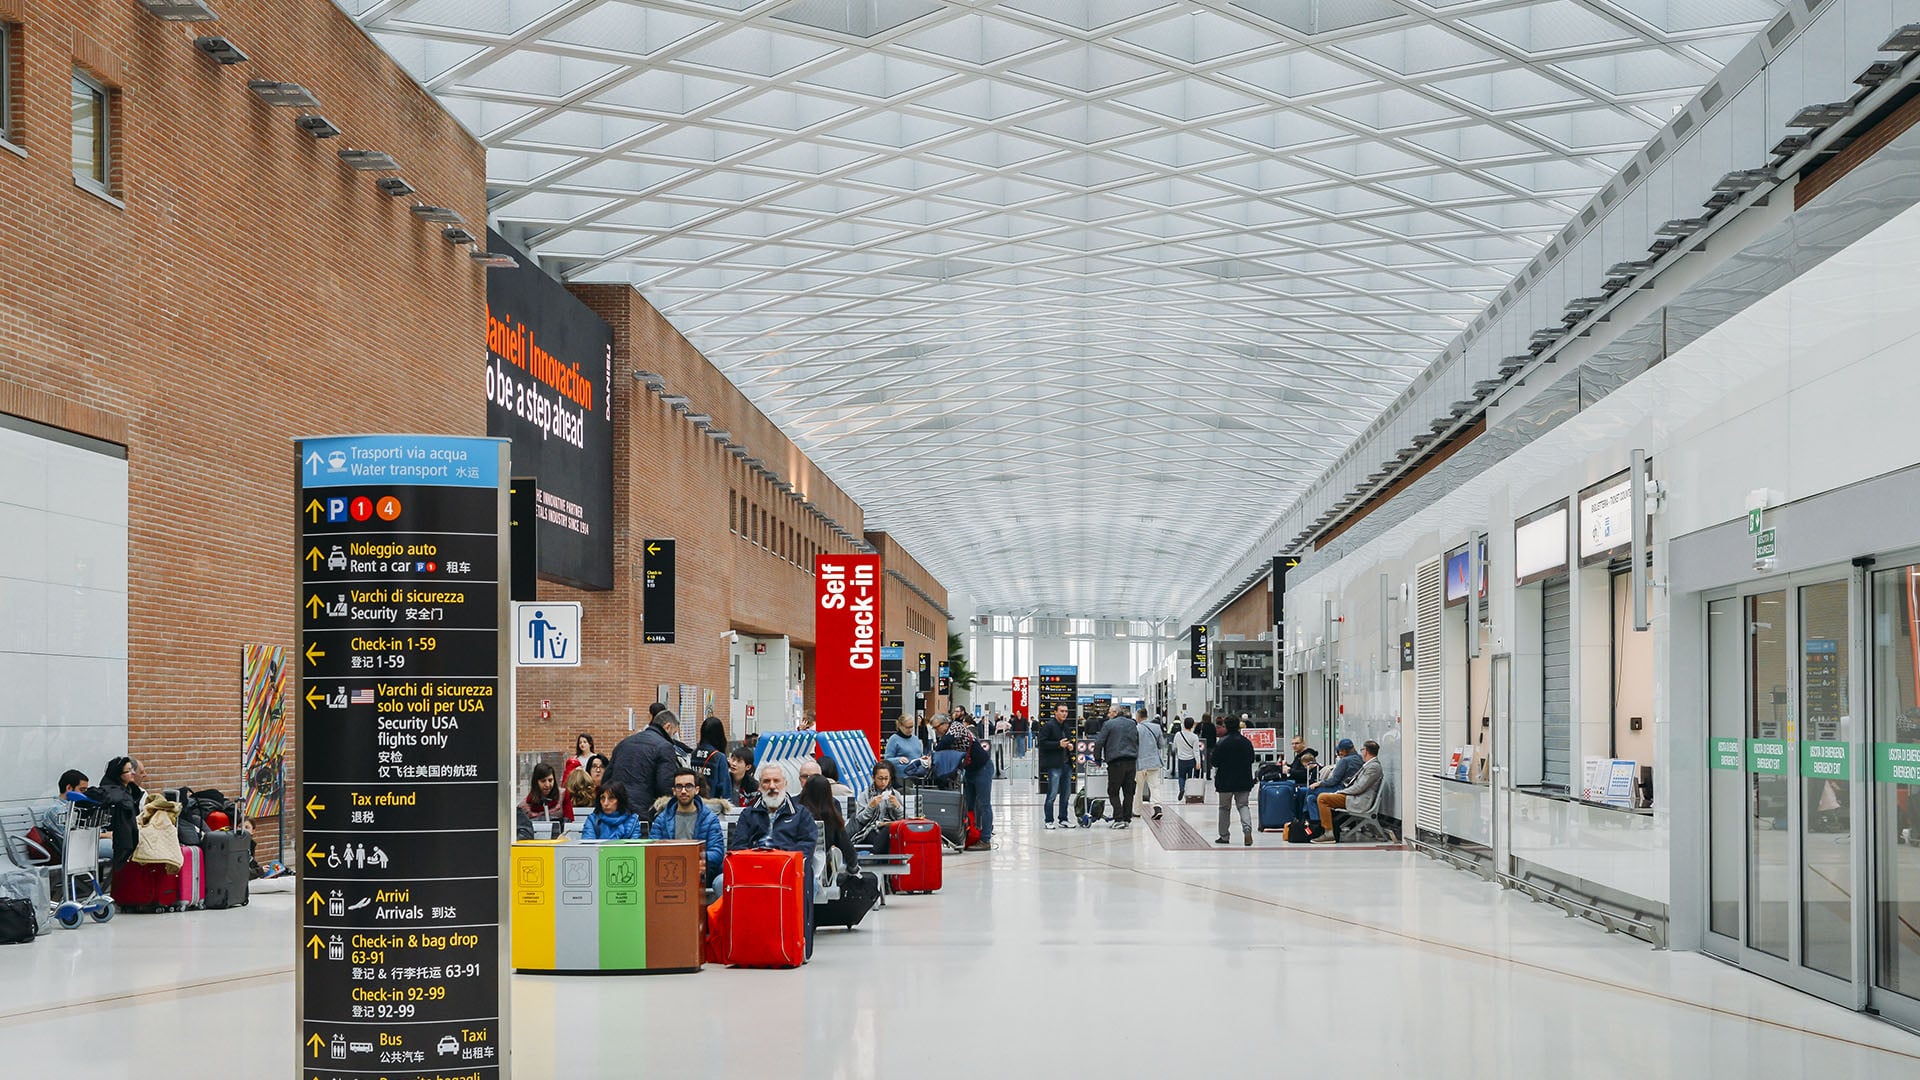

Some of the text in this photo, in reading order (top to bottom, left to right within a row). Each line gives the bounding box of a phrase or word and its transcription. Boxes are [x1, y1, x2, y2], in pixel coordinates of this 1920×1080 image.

[530, 331, 593, 411] Innovaction
[486, 352, 584, 449] o be a step ahead
[351, 446, 467, 463] Trasporti via acqua
[351, 464, 480, 479] Water transport 水运
[330, 500, 394, 521] P 1 4
[536, 504, 547, 520] ETALS
[350, 542, 437, 558] Noleggio auto
[351, 560, 377, 573] Rent
[380, 563, 387, 572] a
[391, 563, 410, 572] car
[446, 561, 471, 574] 租车
[821, 564, 845, 609] Self
[351, 589, 464, 603] Varchi di sicurezza
[351, 607, 444, 623] Security 安全门
[850, 564, 873, 670] Check-in
[351, 637, 436, 651] Check-in 1-59
[351, 655, 405, 669] 登记 1-59
[377, 682, 493, 697] Varchi di sicurezza
[377, 698, 484, 715] solo voli per USA
[377, 716, 458, 732] Security USA
[377, 732, 448, 749] flights only
[378, 751, 403, 763] 安检
[378, 765, 478, 778] 仅飞往美国的航班
[351, 791, 416, 806] Tax refund
[351, 811, 374, 824] 退税
[375, 889, 410, 903] Arrivi
[375, 905, 457, 920] Arrivals 到达
[351, 932, 478, 951] Check-in & bag drop
[351, 951, 385, 965] 63-91
[351, 963, 480, 980] 登记 & 行李托运 63-91
[351, 986, 446, 1002] Check-in 92-99
[351, 1004, 415, 1018] 登记 92-99
[380, 1032, 403, 1047] Bus
[461, 1027, 487, 1042] Taxi
[380, 1050, 425, 1063] 公共汽车
[462, 1046, 495, 1059] 出租车
